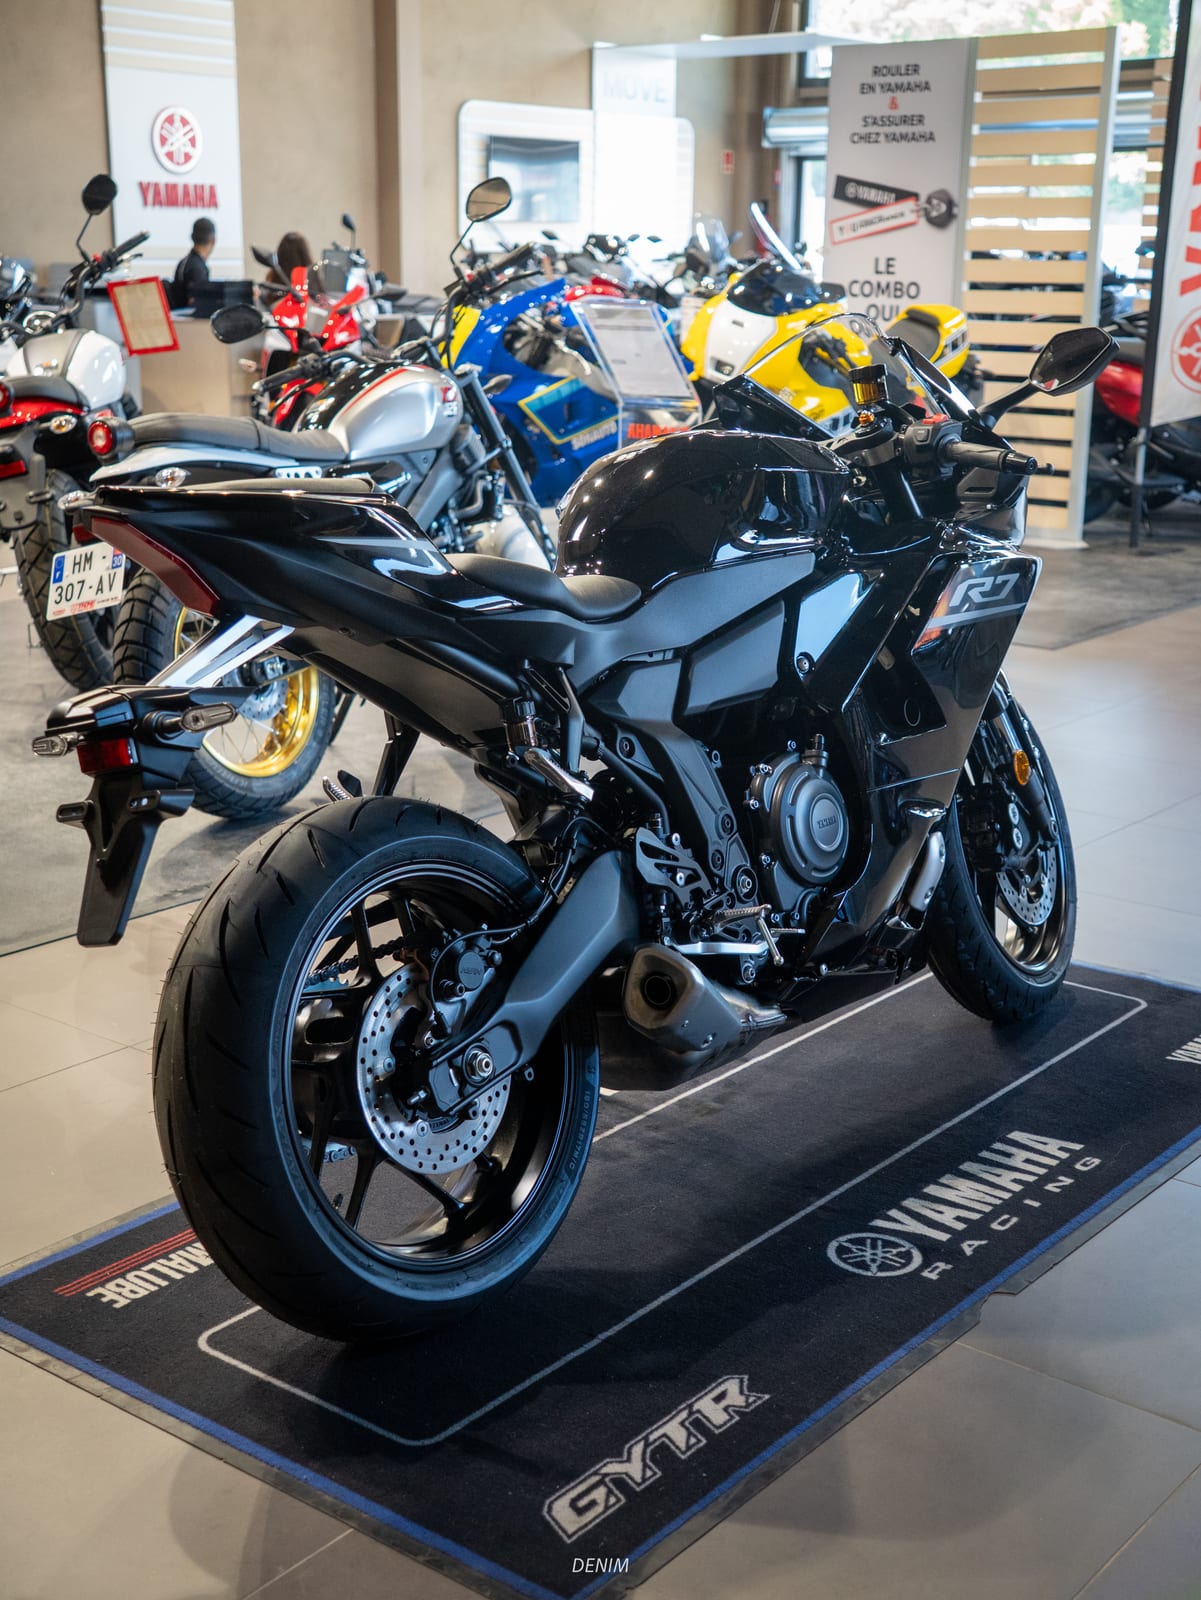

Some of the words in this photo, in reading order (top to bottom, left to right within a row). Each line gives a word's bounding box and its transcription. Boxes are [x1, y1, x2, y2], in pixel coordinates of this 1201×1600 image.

[872, 64, 920, 77] ROULER
[860, 82, 876, 94] EN
[879, 80, 931, 93] YAMAHA
[888, 96, 899, 110] &
[862, 114, 925, 127] S'ASSURER
[850, 132, 881, 144] CHEZ
[884, 131, 936, 143] YAMAHA
[138, 181, 218, 208] YAMAHA
[874, 257, 896, 275] LE
[848, 280, 920, 299] COMBO
[54, 572, 117, 604] 307-AV
[949, 573, 1020, 607] R7
[868, 1130, 1085, 1242] YAMAHA
[920, 1156, 1102, 1280] RACING
[85, 1241, 215, 1309] MALUBE
[542, 1375, 771, 1544] GYTR
